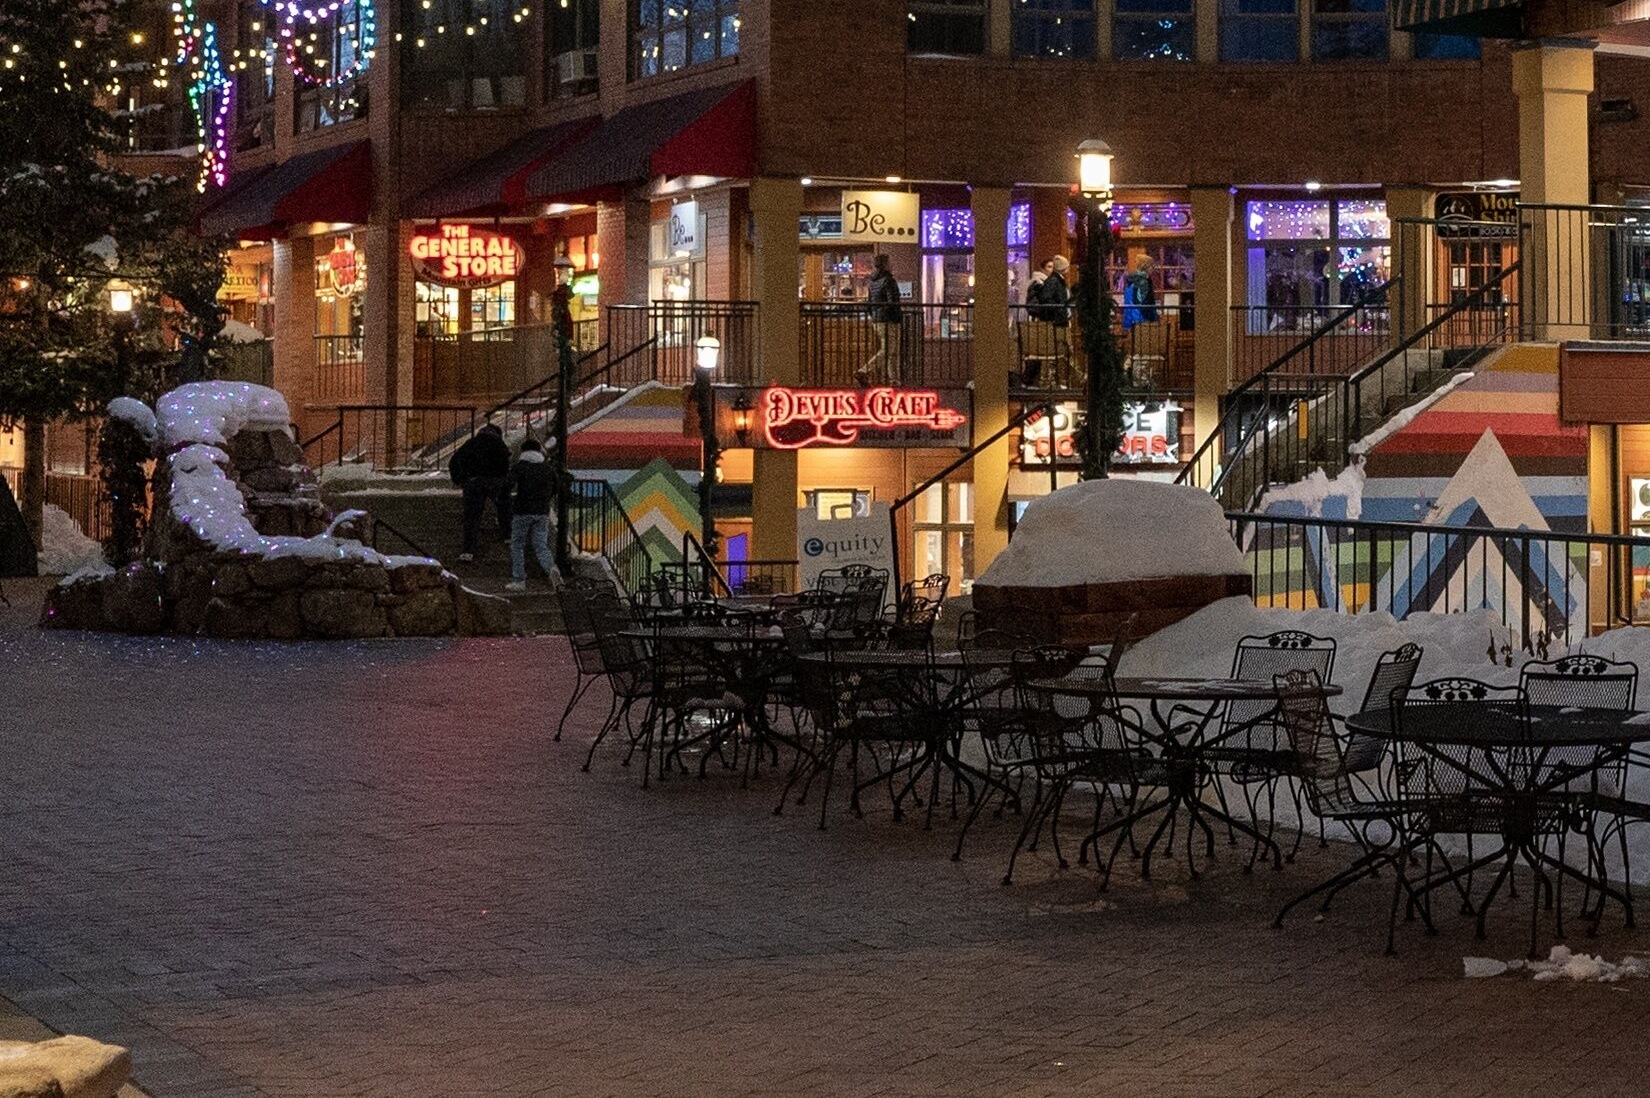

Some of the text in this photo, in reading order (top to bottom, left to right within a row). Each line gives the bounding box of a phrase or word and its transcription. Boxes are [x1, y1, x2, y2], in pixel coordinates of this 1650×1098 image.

[442, 224, 469, 238] THE
[410, 235, 515, 259] GENERAL
[442, 255, 515, 278] STORE
[223, 276, 259, 287] EXICO
[769, 388, 937, 426] DEVIL'S CRAFT
[804, 533, 885, 558] equity
